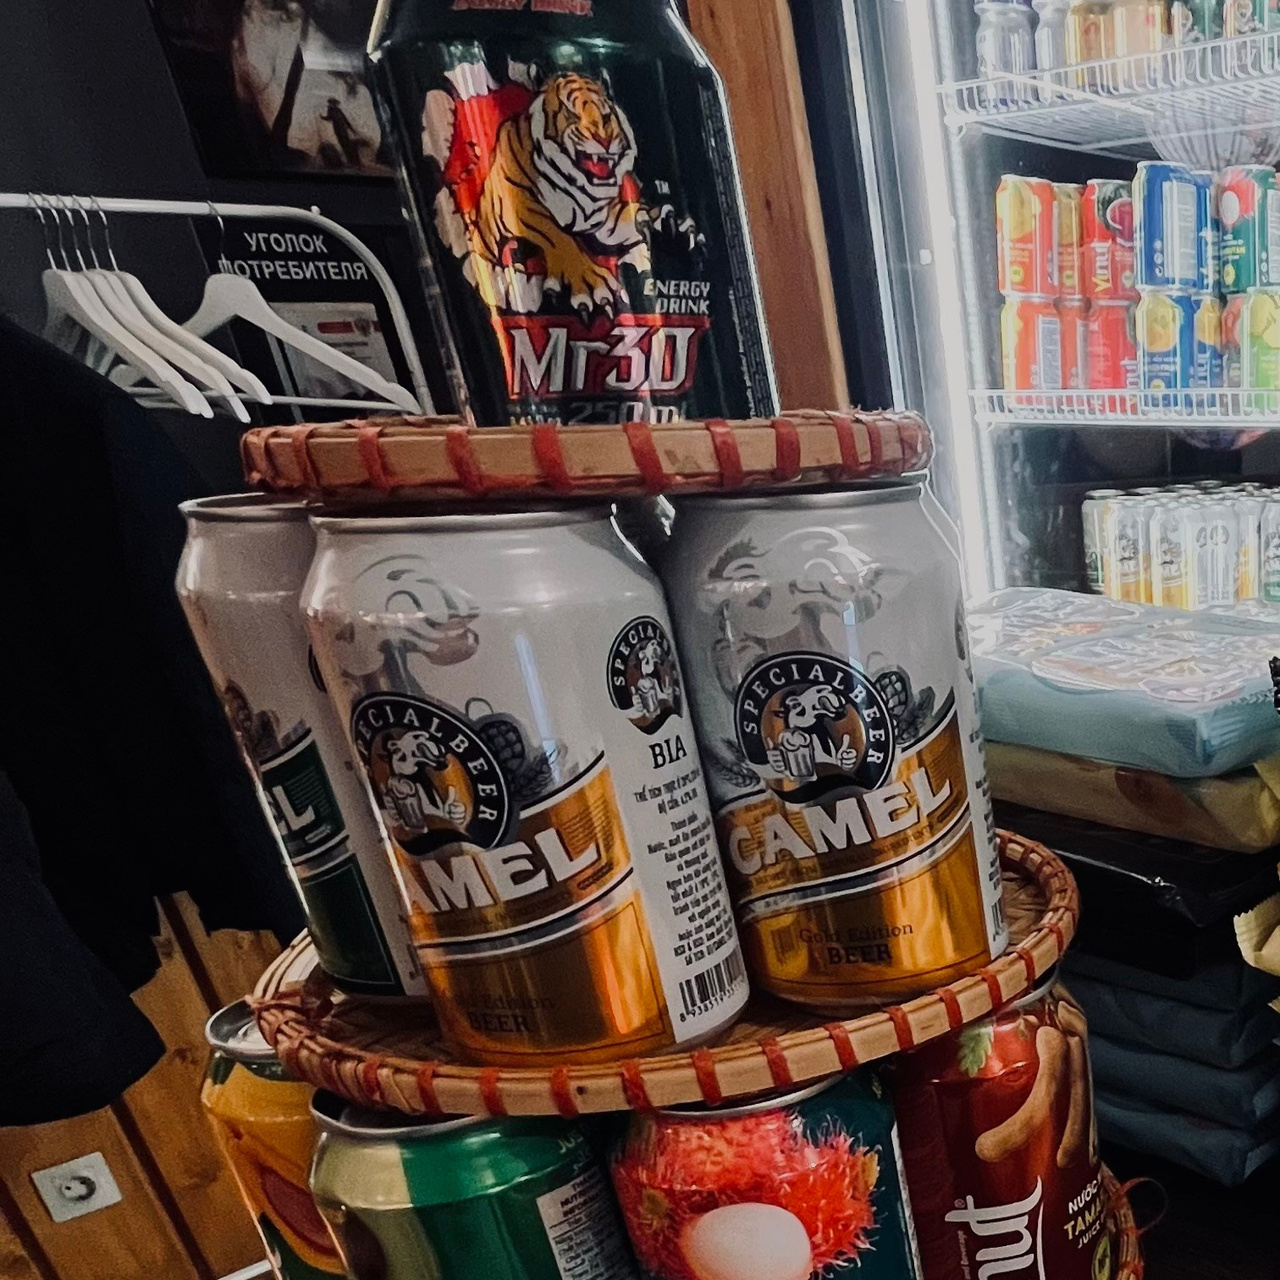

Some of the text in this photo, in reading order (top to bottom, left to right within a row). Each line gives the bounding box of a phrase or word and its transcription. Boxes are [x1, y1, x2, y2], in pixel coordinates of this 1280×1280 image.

[243, 232, 328, 254] УГОЛОК
[218, 260, 369, 280] ПОТРЕБИТЕЛЯ
[643, 279, 710, 297] ENERGY
[656, 299, 710, 315] DRINK
[614, 625, 662, 687] SPECIAL
[744, 664, 886, 765] SPECIAL BEER
[649, 735, 687, 769] BIA
[449, 733, 498, 821] BEER
[729, 766, 951, 875] CAMEL
[799, 927, 840, 944] Gold
[827, 943, 893, 965] BEER
